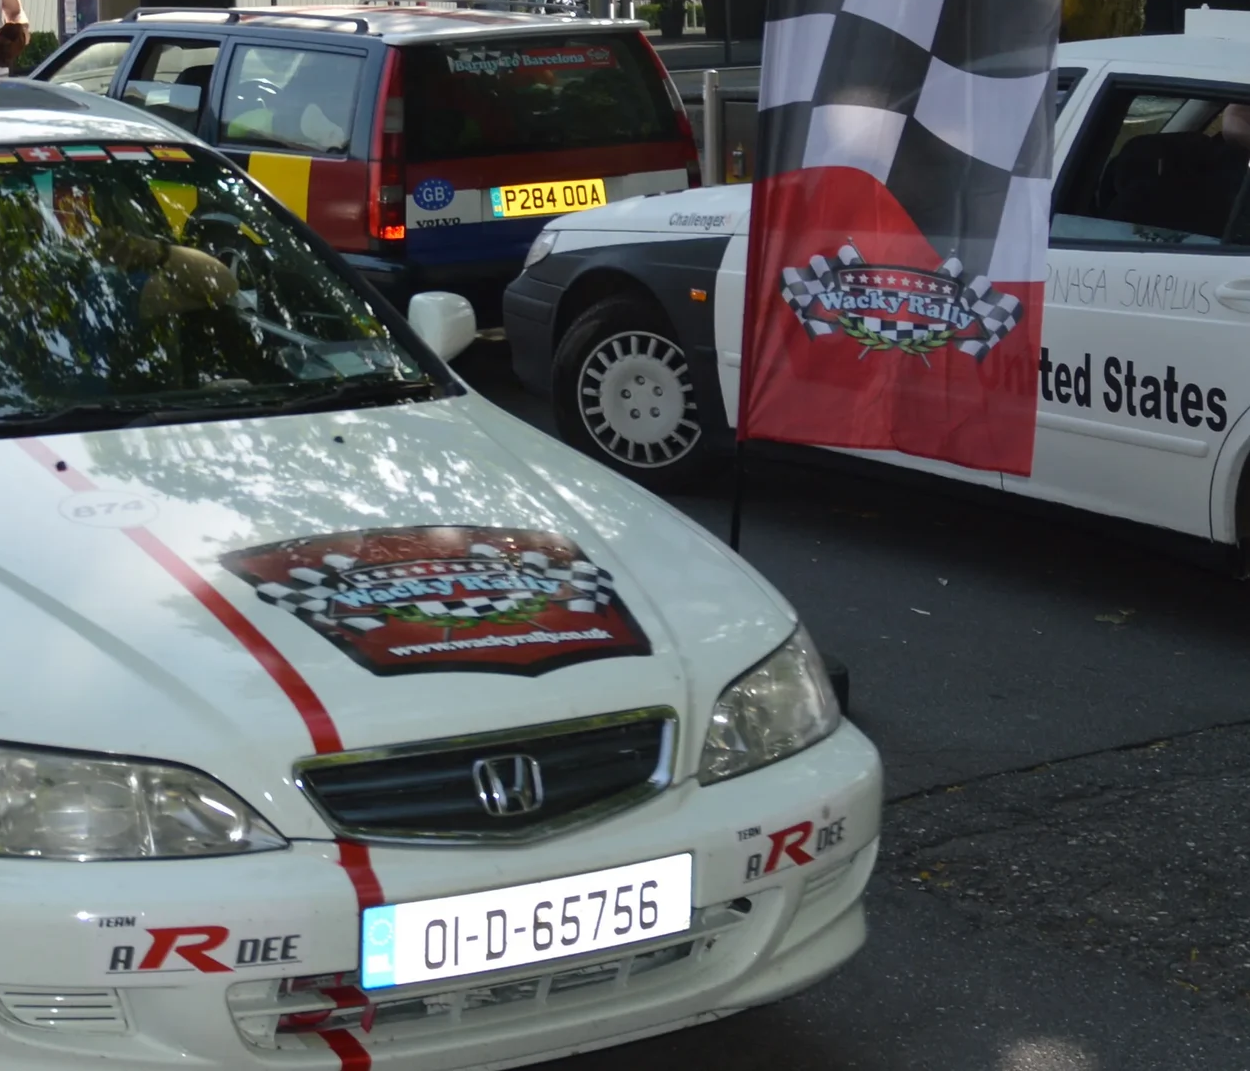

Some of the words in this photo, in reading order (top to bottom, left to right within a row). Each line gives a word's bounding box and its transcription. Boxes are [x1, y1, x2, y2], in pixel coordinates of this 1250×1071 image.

[454, 59, 500, 73] Barmy
[502, 55, 519, 67] To
[521, 52, 586, 66] Barcelona
[422, 186, 446, 203] GB
[504, 187, 557, 211] P284
[1119, 268, 1211, 315] SURPLUS
[818, 290, 904, 314] Wacky
[908, 294, 976, 330] Rally
[1103, 356, 1228, 432] States
[332, 578, 454, 608] Wacky
[456, 573, 561, 594] Rally
[99, 916, 137, 928] TEAM
